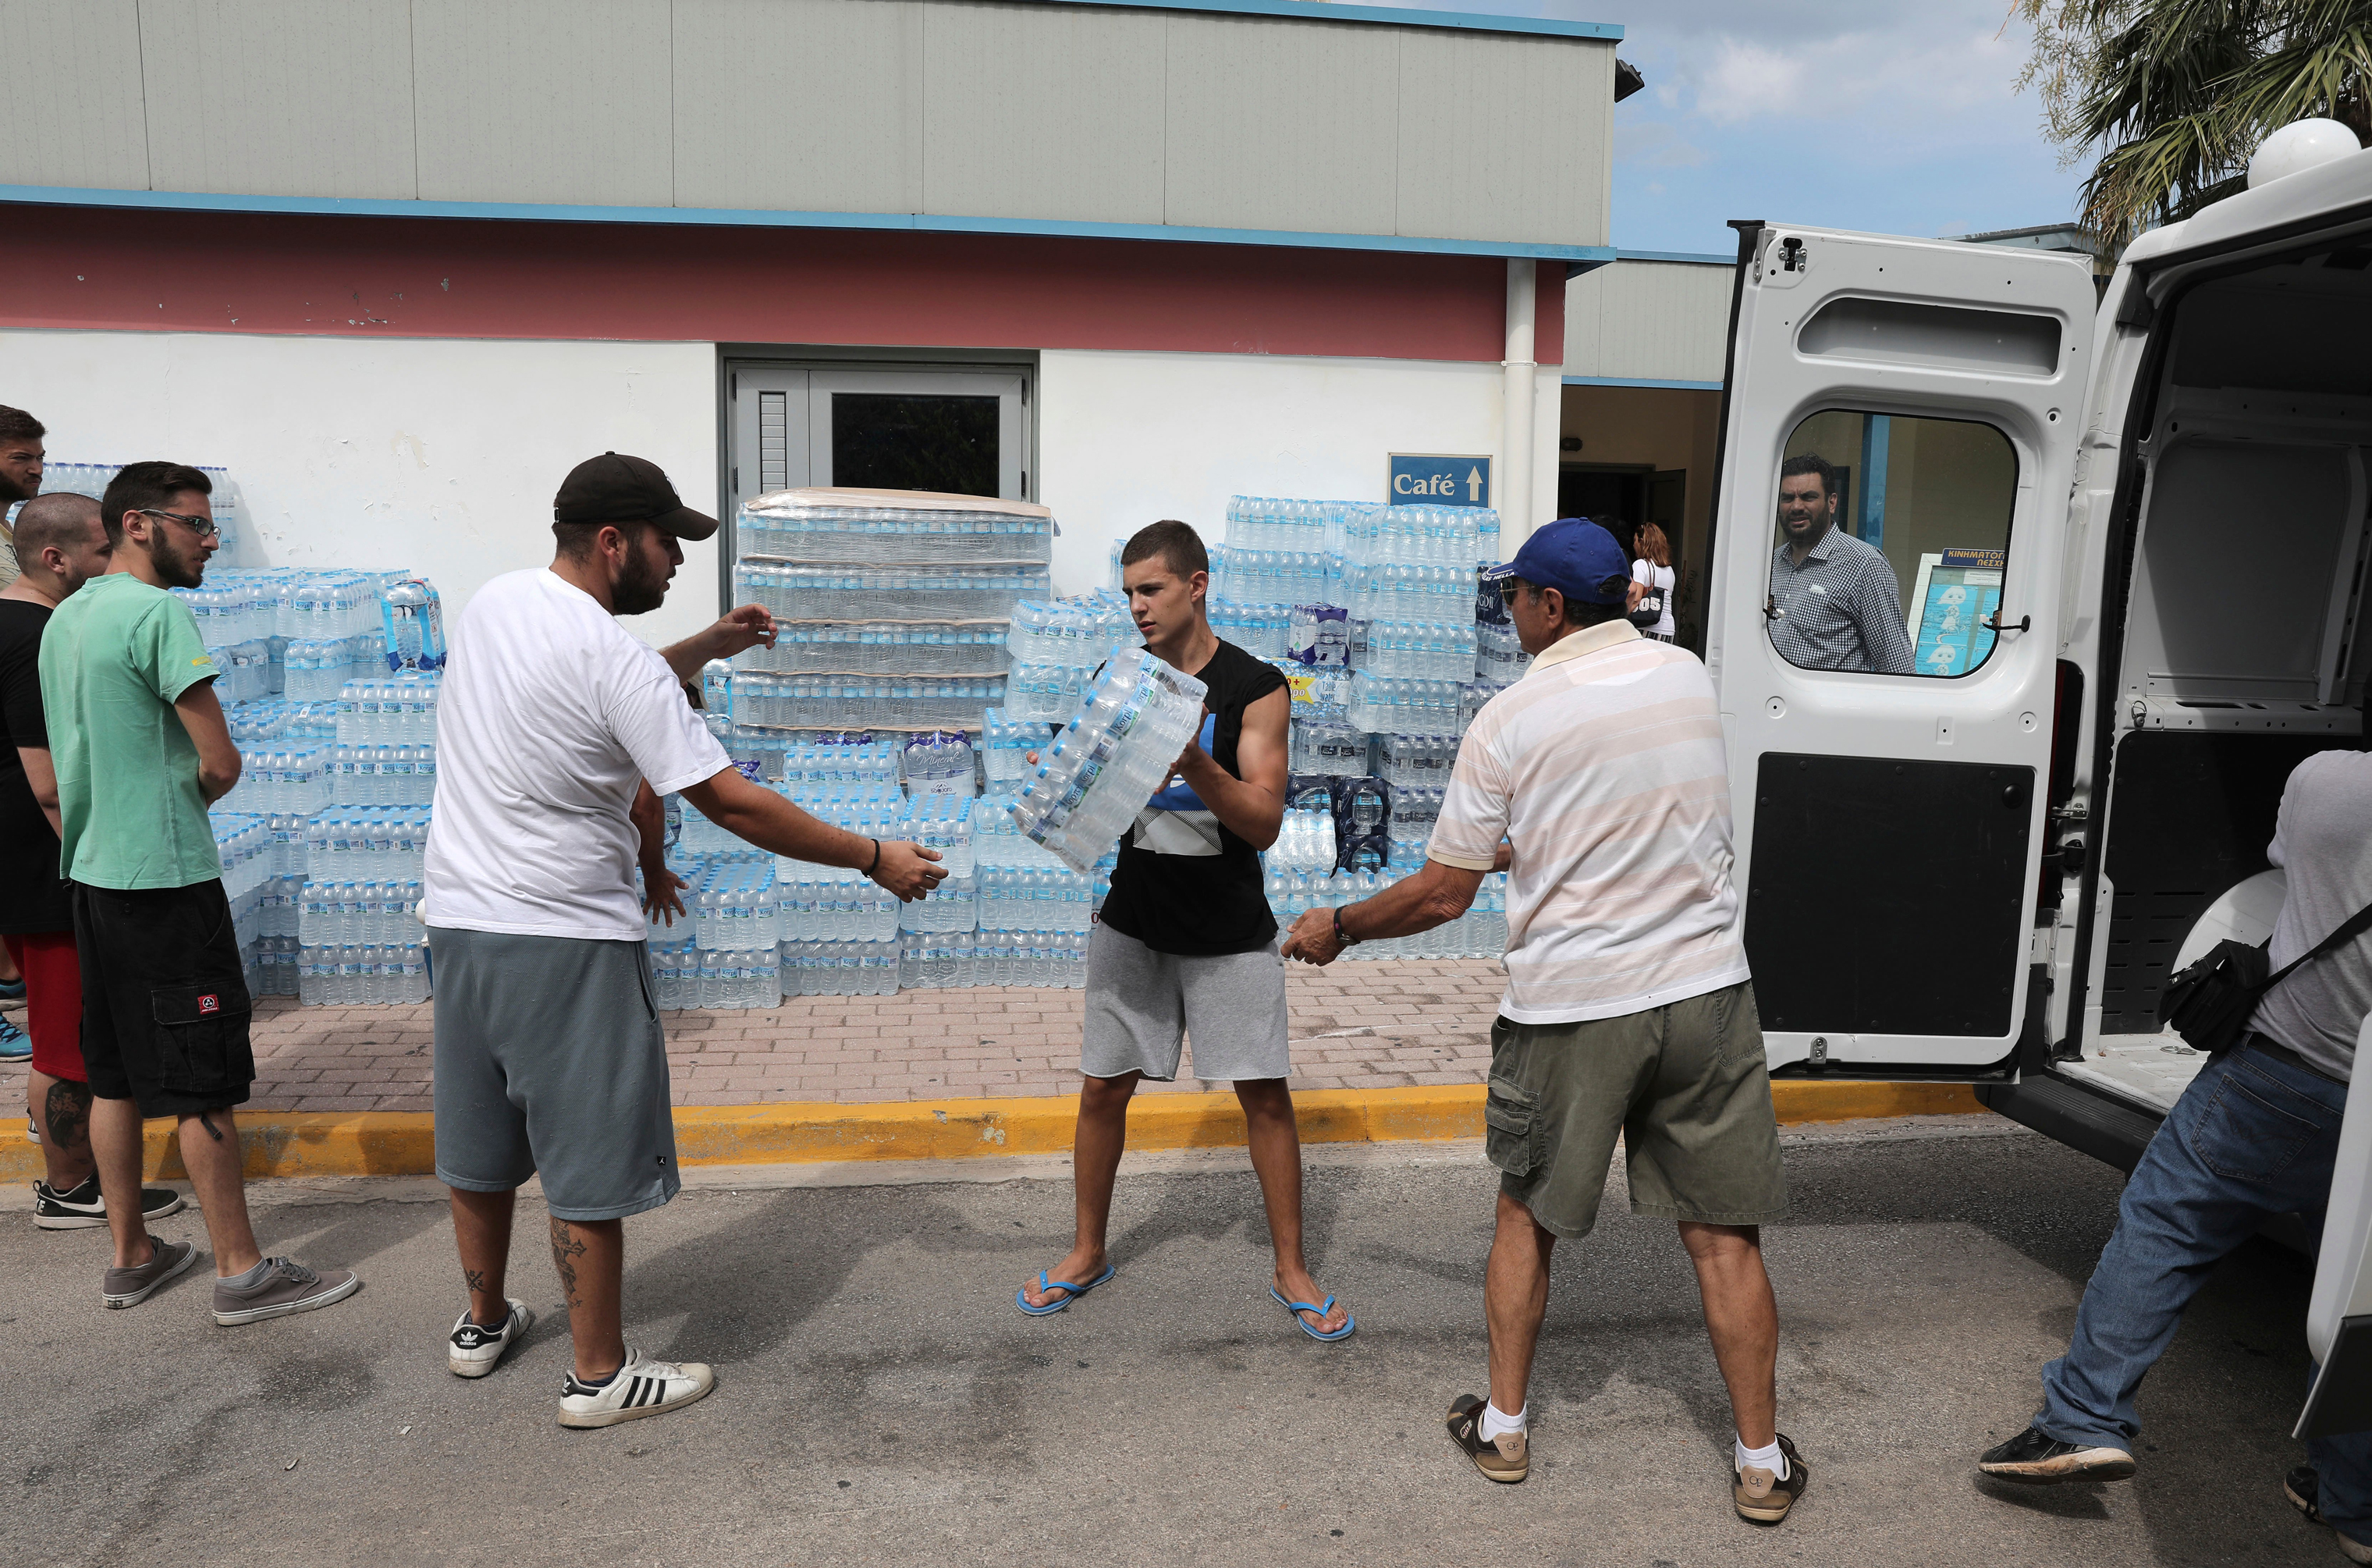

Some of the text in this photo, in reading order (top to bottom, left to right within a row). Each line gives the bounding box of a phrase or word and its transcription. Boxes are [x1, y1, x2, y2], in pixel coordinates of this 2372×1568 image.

[1394, 473, 1455, 495] Café
[1143, 654, 1158, 672] Κορπ
[1137, 686, 1149, 703] orpi
[1322, 681, 1336, 691] Table
[1115, 709, 1132, 731] Korpi
[916, 751, 964, 768] Mineral
